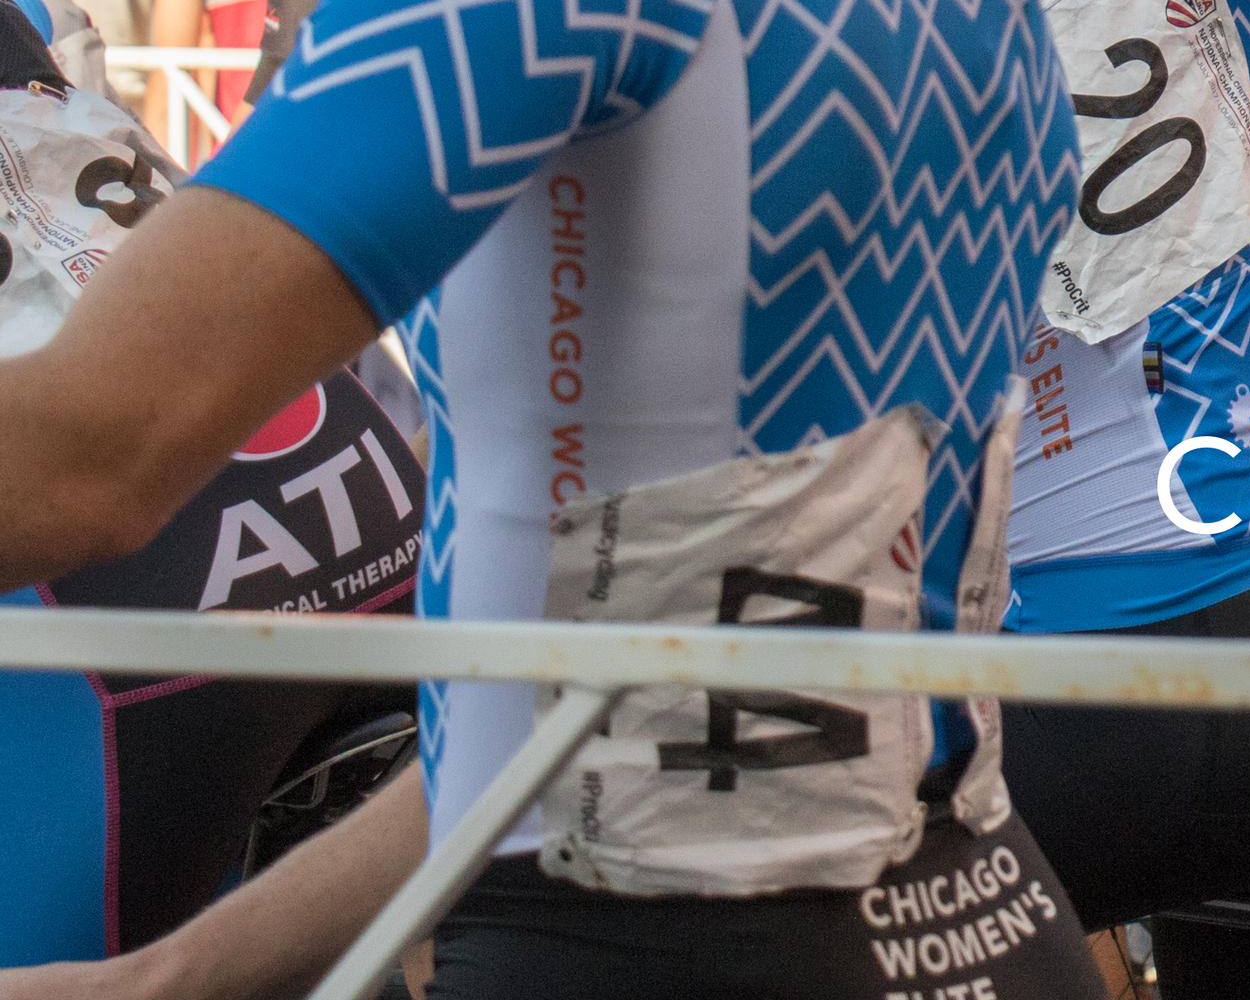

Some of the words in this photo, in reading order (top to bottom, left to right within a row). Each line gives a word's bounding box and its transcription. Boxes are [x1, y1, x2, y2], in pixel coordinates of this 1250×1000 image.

[1198, 27, 1222, 75] NATIONAL
[1206, 22, 1235, 81] PROFESSIONAL
[1071, 37, 1207, 236] 20
[35, 213, 79, 249] NATIONAL
[549, 175, 586, 405] CHICAGO
[1052, 260, 1091, 316] #ProCrit
[1031, 363, 1073, 461] ELITE
[198, 428, 413, 612] ATI
[860, 844, 1021, 928] CHICAGO
[870, 879, 1058, 981] WOMEN'S
